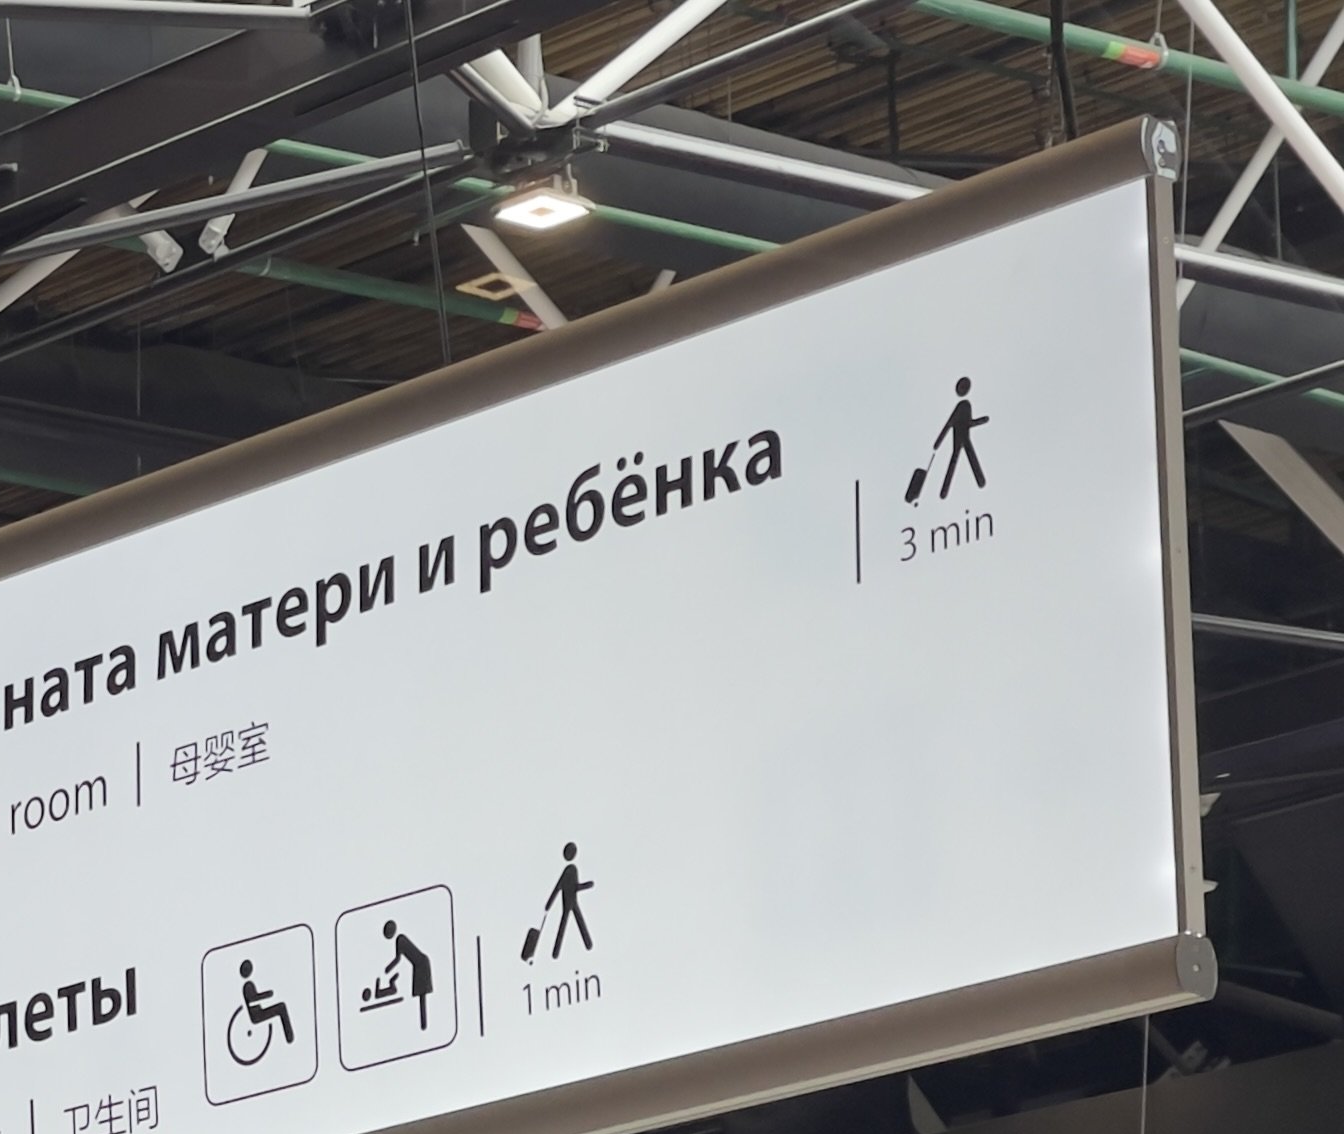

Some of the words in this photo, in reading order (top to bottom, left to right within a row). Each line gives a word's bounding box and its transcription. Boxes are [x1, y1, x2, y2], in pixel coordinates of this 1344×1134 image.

[158, 556, 394, 680] матери
[419, 536, 454, 593] и
[480, 430, 781, 593] ребёнка
[901, 527, 916, 561] 3
[931, 510, 993, 552] min
[170, 722, 269, 785] 母婴室
[11, 776, 106, 834] room
[523, 984, 531, 1014] 1
[546, 971, 600, 1010] min
